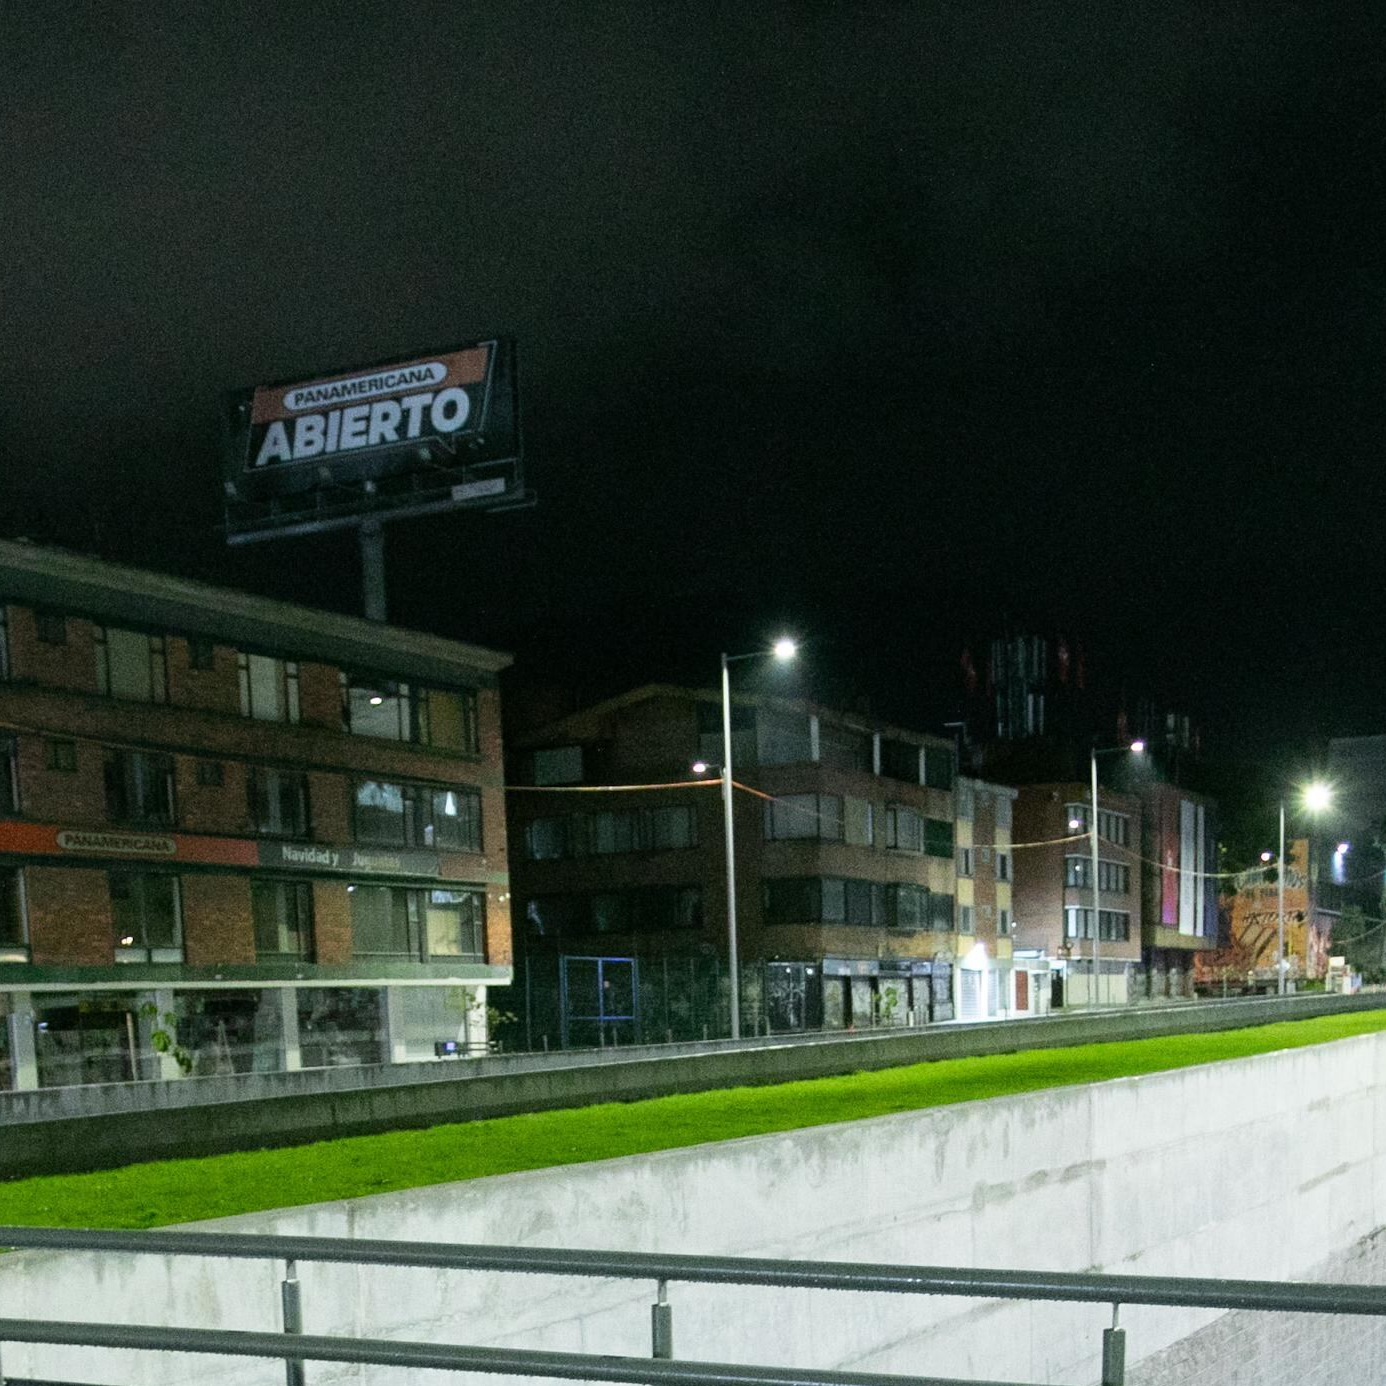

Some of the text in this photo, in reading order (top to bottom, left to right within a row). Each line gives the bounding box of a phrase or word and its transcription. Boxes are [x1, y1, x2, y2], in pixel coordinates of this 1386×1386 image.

[294, 367, 435, 407] PANAMERICANA
[255, 387, 470, 467] ABIERTO
[282, 846, 329, 865] Navidad
[332, 853, 340, 867] y
